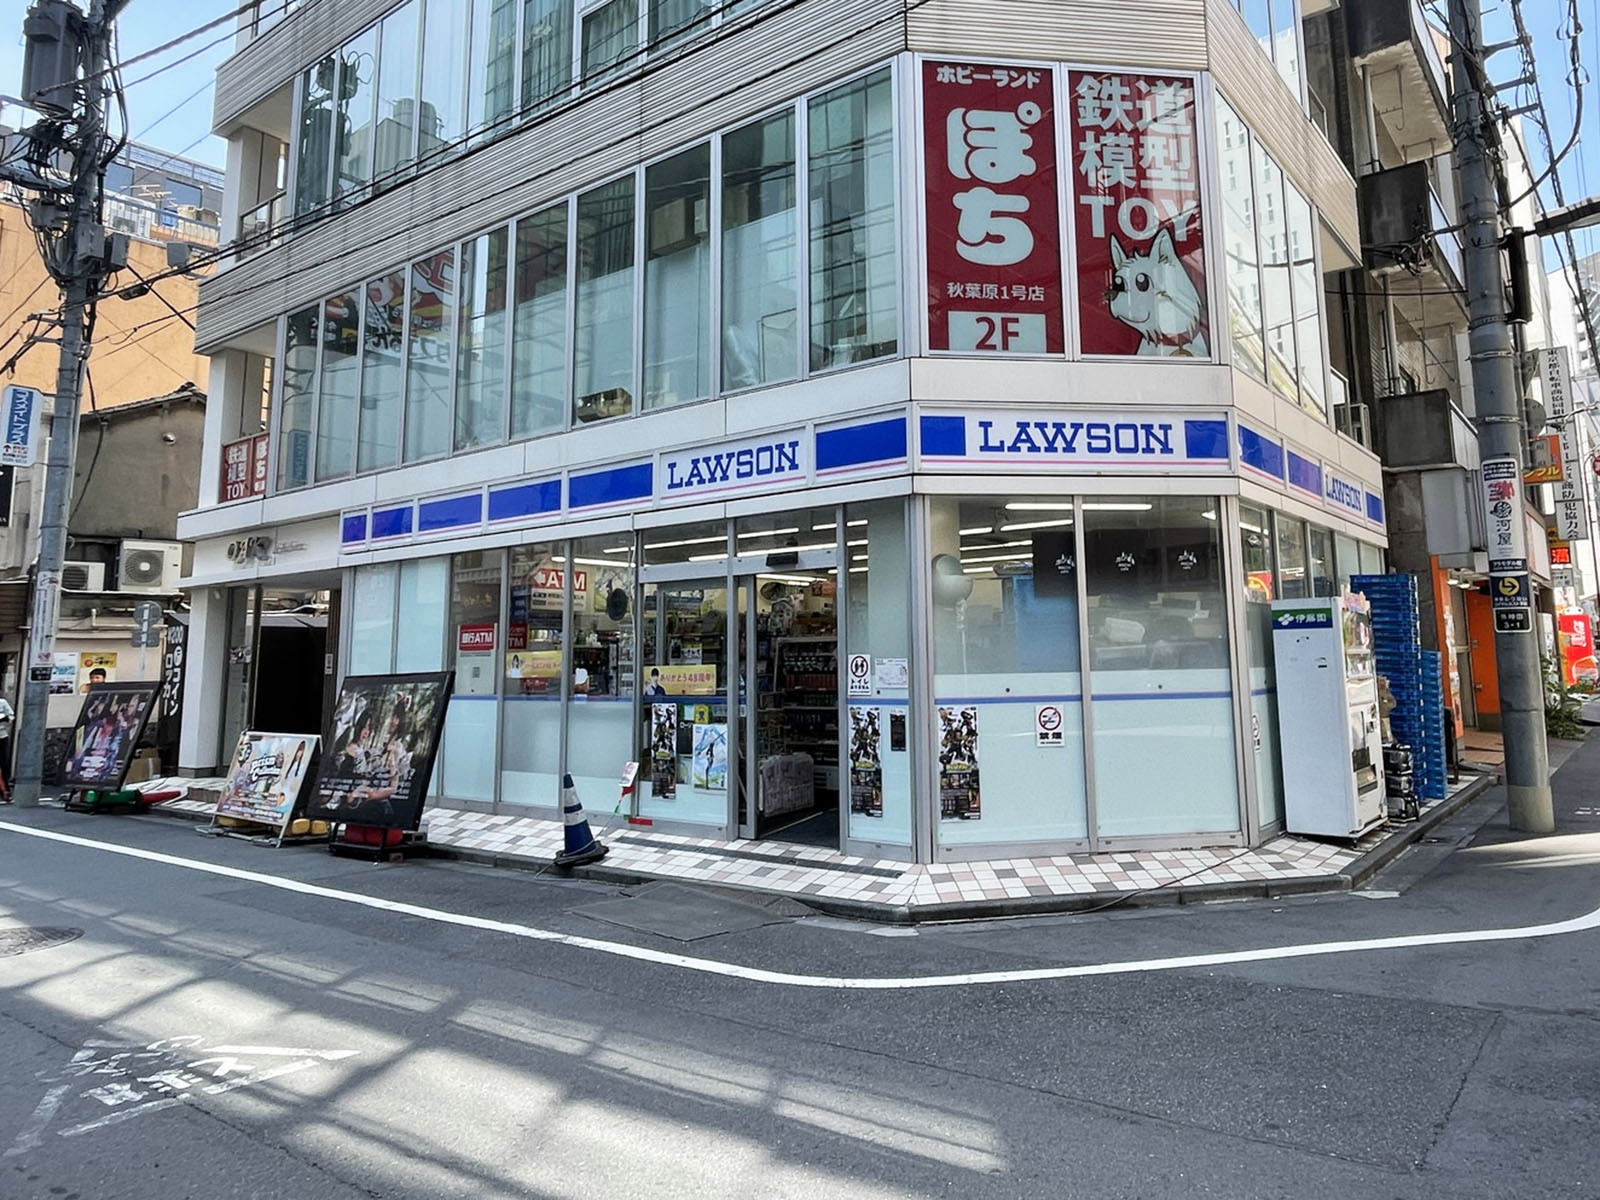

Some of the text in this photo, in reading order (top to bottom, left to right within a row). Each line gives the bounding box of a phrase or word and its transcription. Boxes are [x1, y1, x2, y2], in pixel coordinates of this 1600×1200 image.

[936, 65, 1041, 89] ホビーランド
[1075, 75, 1191, 135] 鉄道
[1079, 131, 1197, 191] 模型
[947, 101, 1042, 266] ぽち
[1079, 195, 1200, 242] TOY
[947, 283, 1045, 302] 秋葉原1号店
[975, 316, 1020, 351] 2F
[978, 419, 1174, 455] LAWSON
[667, 441, 799, 490] LAWSON
[226, 482, 246, 500] TOY
[1325, 474, 1362, 512] LAWSON
[545, 571, 586, 591] ATM
